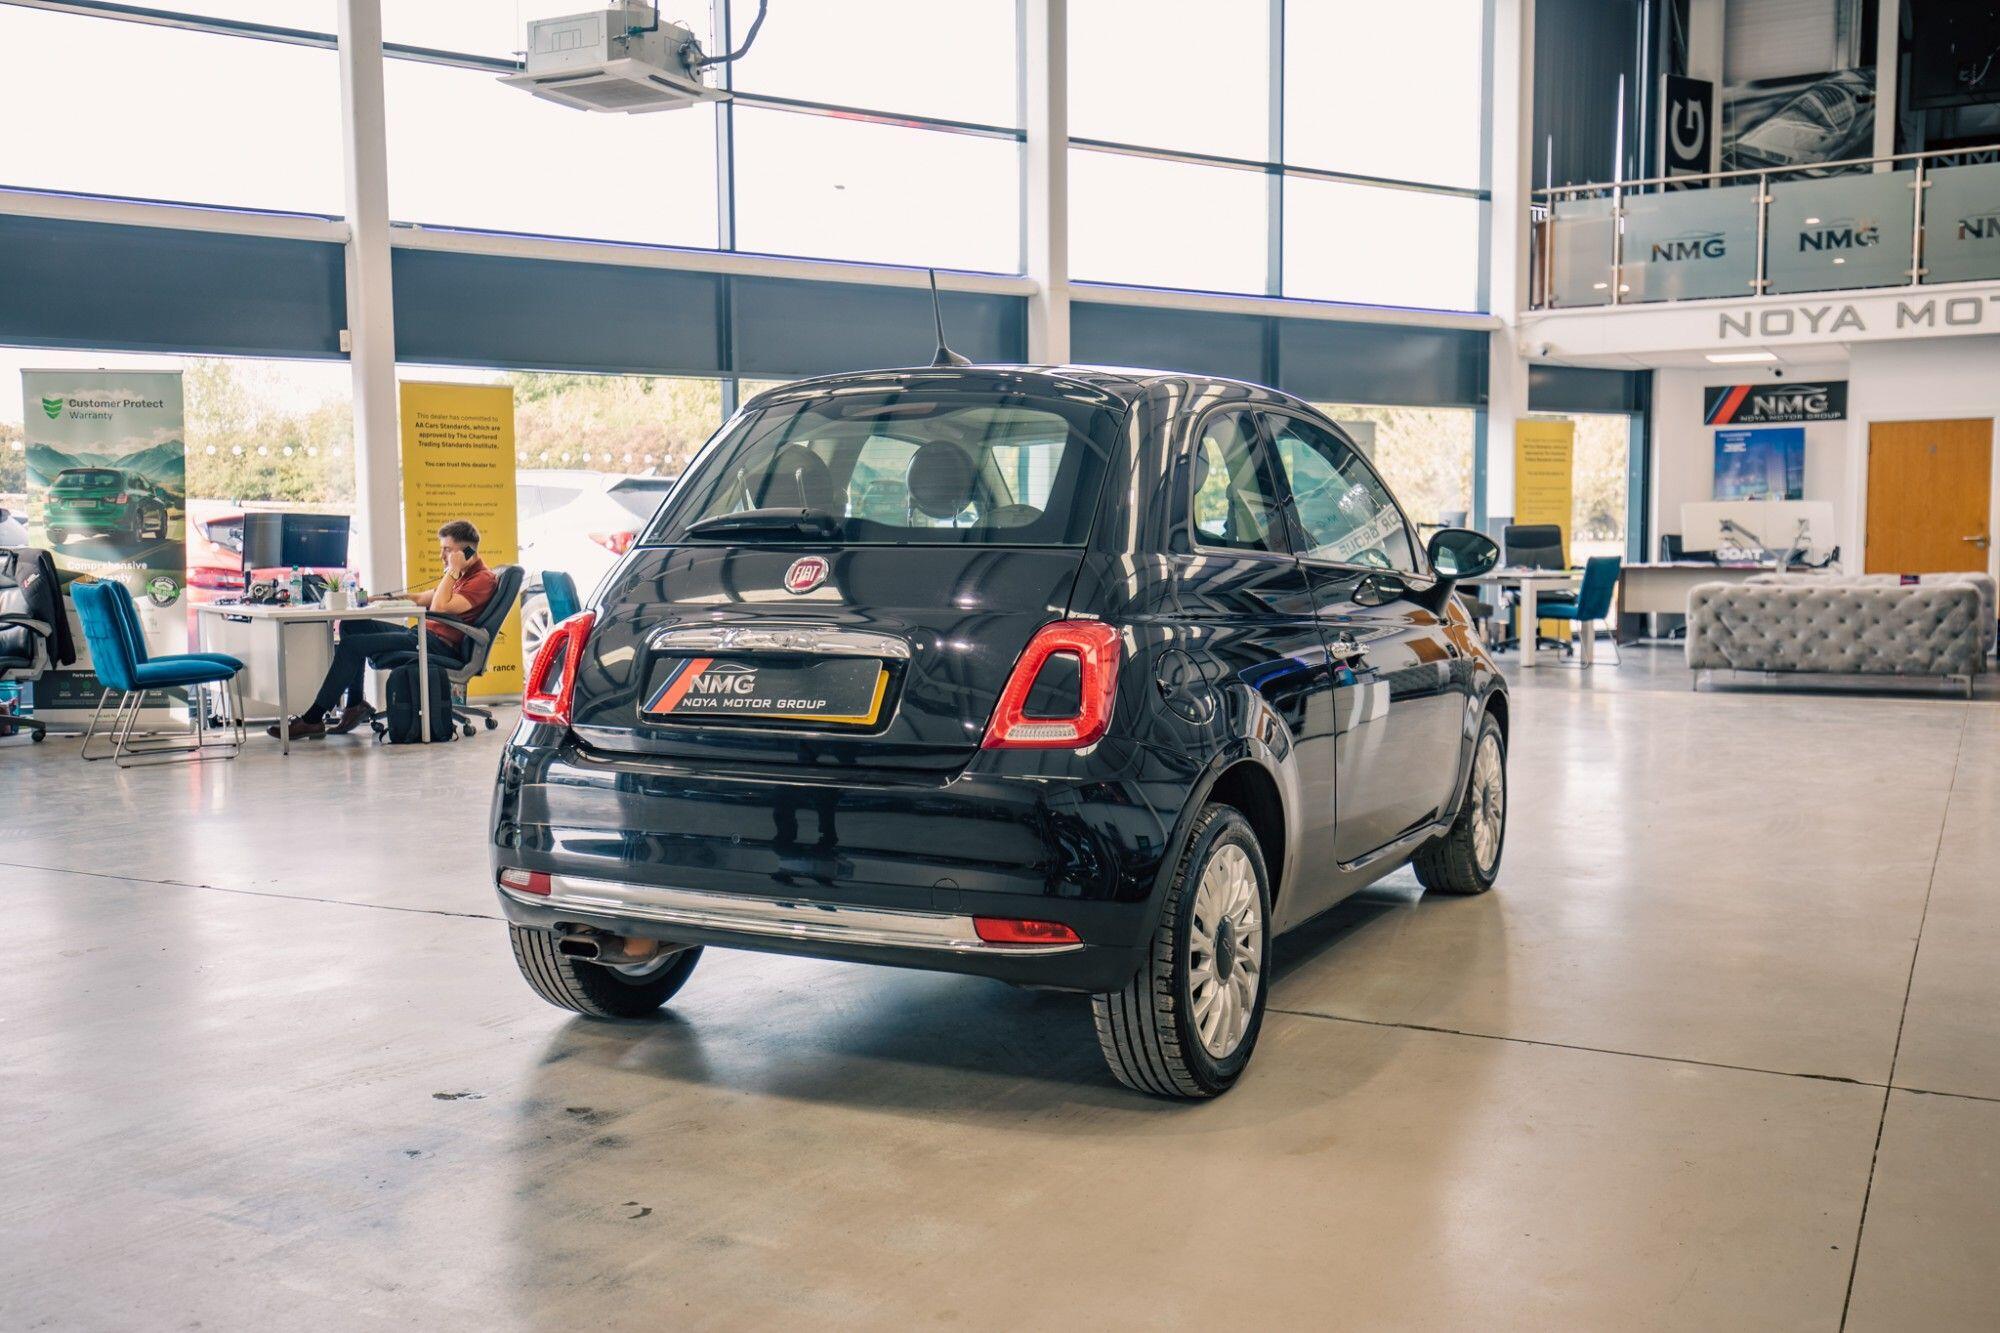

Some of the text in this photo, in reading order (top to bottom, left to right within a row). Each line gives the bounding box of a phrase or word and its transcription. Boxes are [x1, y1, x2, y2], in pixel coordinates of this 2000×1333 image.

[1799, 227, 1879, 252] NMG
[1651, 239, 1726, 262] NMG
[1719, 297, 2000, 339] NOYA MO
[69, 399, 164, 408] Customer Protect
[1753, 394, 1829, 415] NMG
[69, 411, 113, 420] Warranty
[418, 440, 440, 448] Trading
[66, 560, 148, 571] Comprehensive
[791, 565, 821, 582] FIAT
[688, 674, 756, 694] NMG
[682, 698, 827, 709] NOYA MOTOR GROUP
